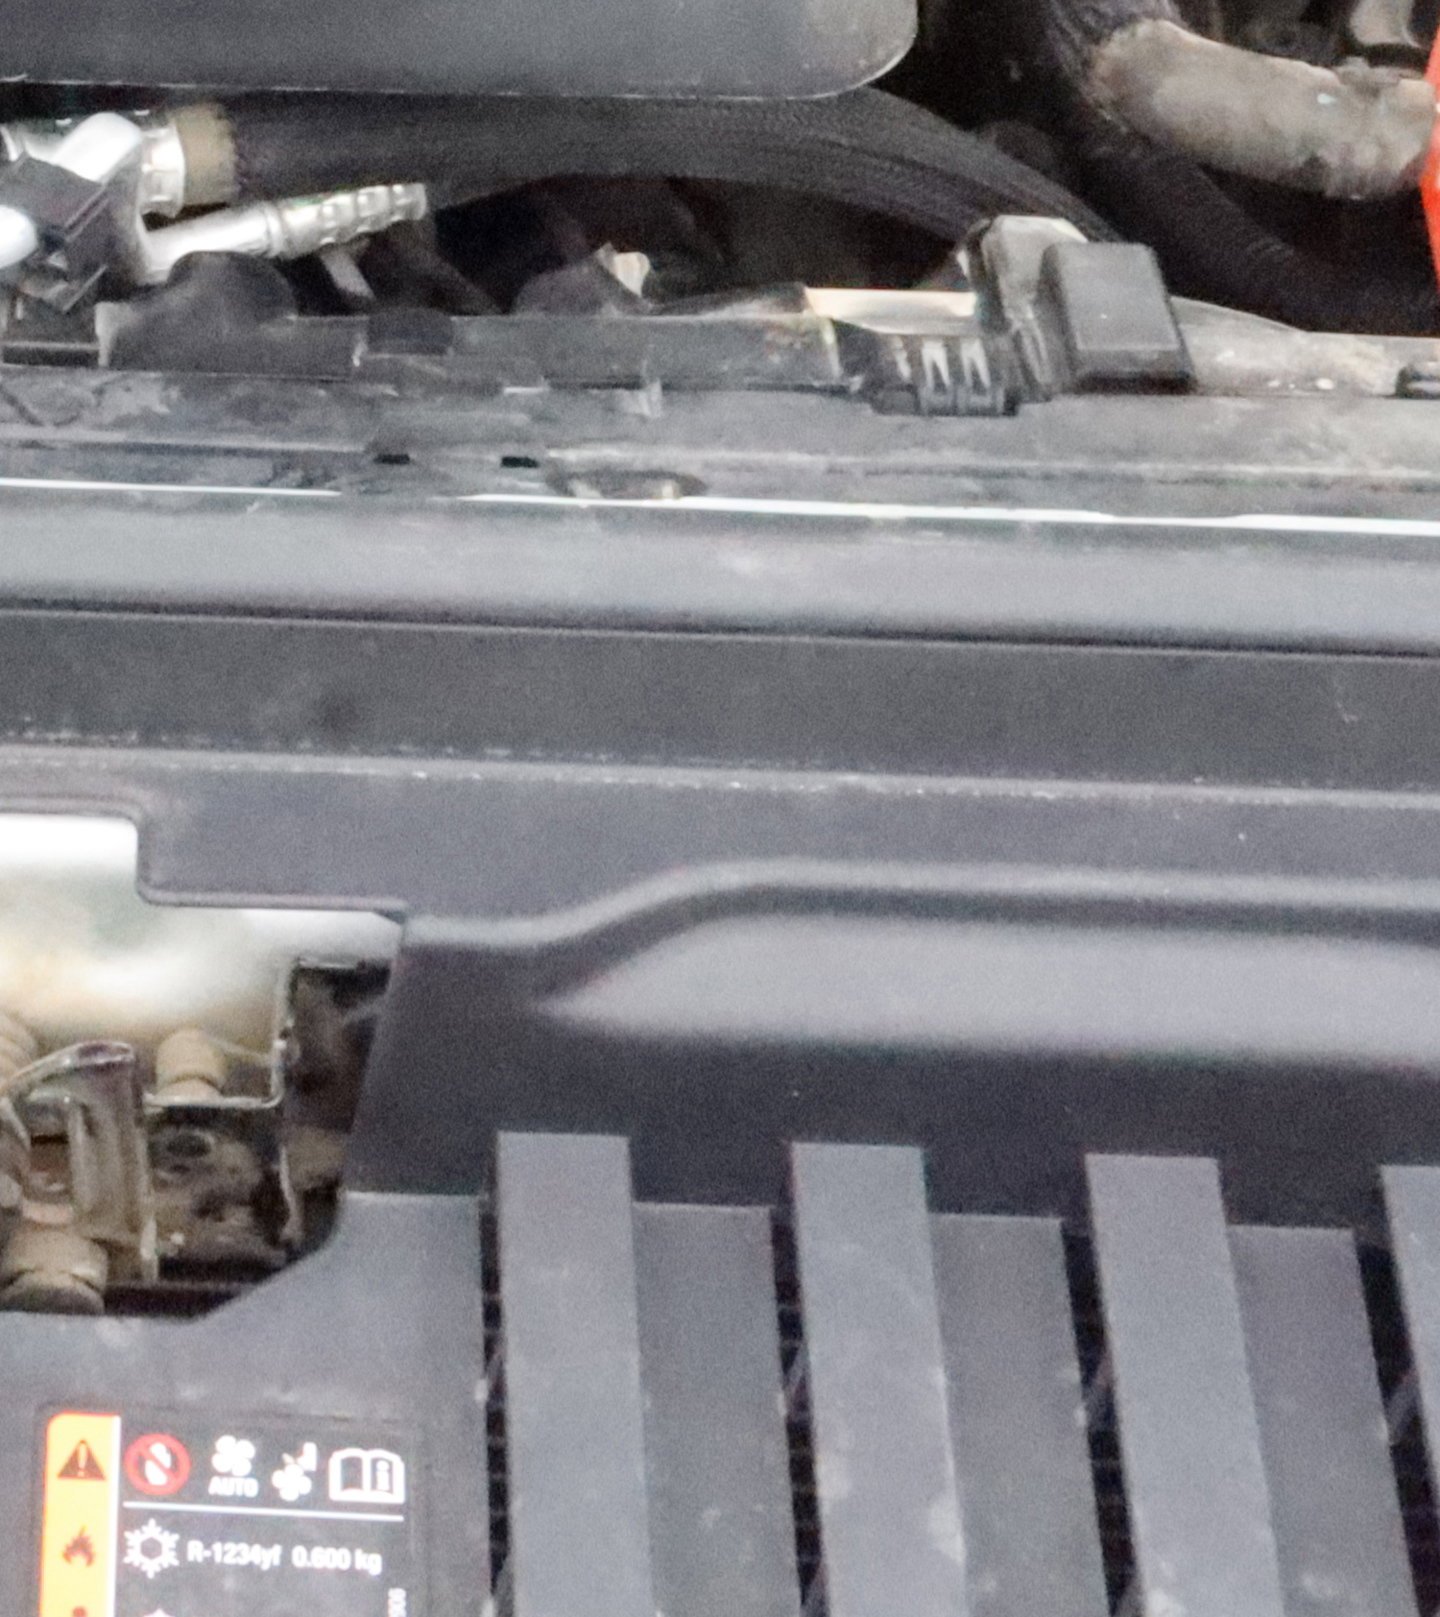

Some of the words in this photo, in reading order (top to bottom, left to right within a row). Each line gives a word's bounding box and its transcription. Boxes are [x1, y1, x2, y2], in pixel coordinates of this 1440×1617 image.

[207, 1475, 259, 1499] AUTO
[186, 1539, 283, 1571] R-1234yf
[290, 1544, 353, 1571] 0.600
[353, 1548, 384, 1577] kg
